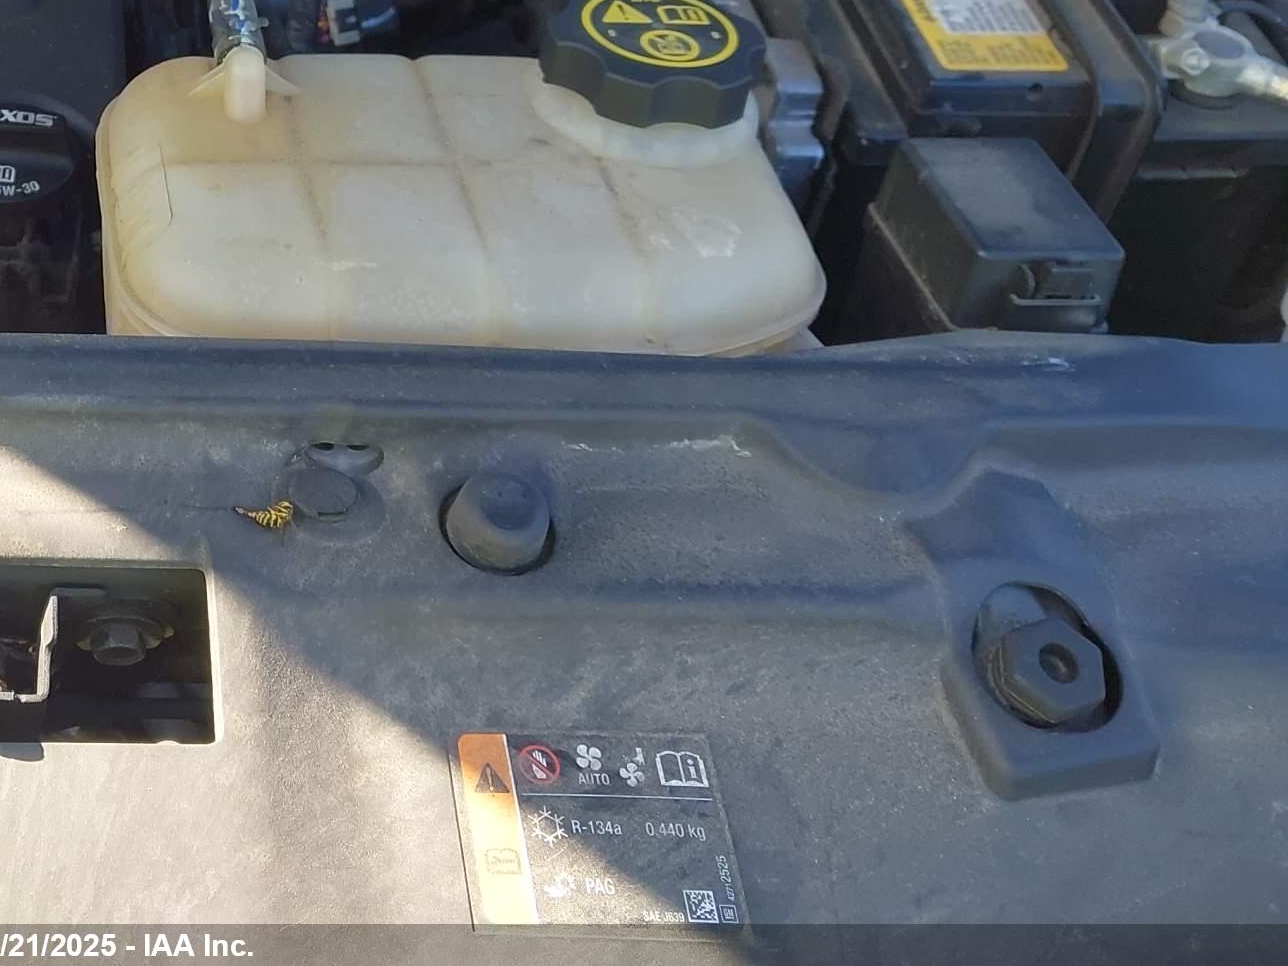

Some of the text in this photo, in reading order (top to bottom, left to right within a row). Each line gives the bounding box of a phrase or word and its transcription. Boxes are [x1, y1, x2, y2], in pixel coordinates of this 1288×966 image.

[578, 773, 610, 785] AUTO
[571, 820, 706, 841] R-134a 0.440 kg
[585, 878, 616, 895] PAG
[642, 910, 662, 922] SAE
